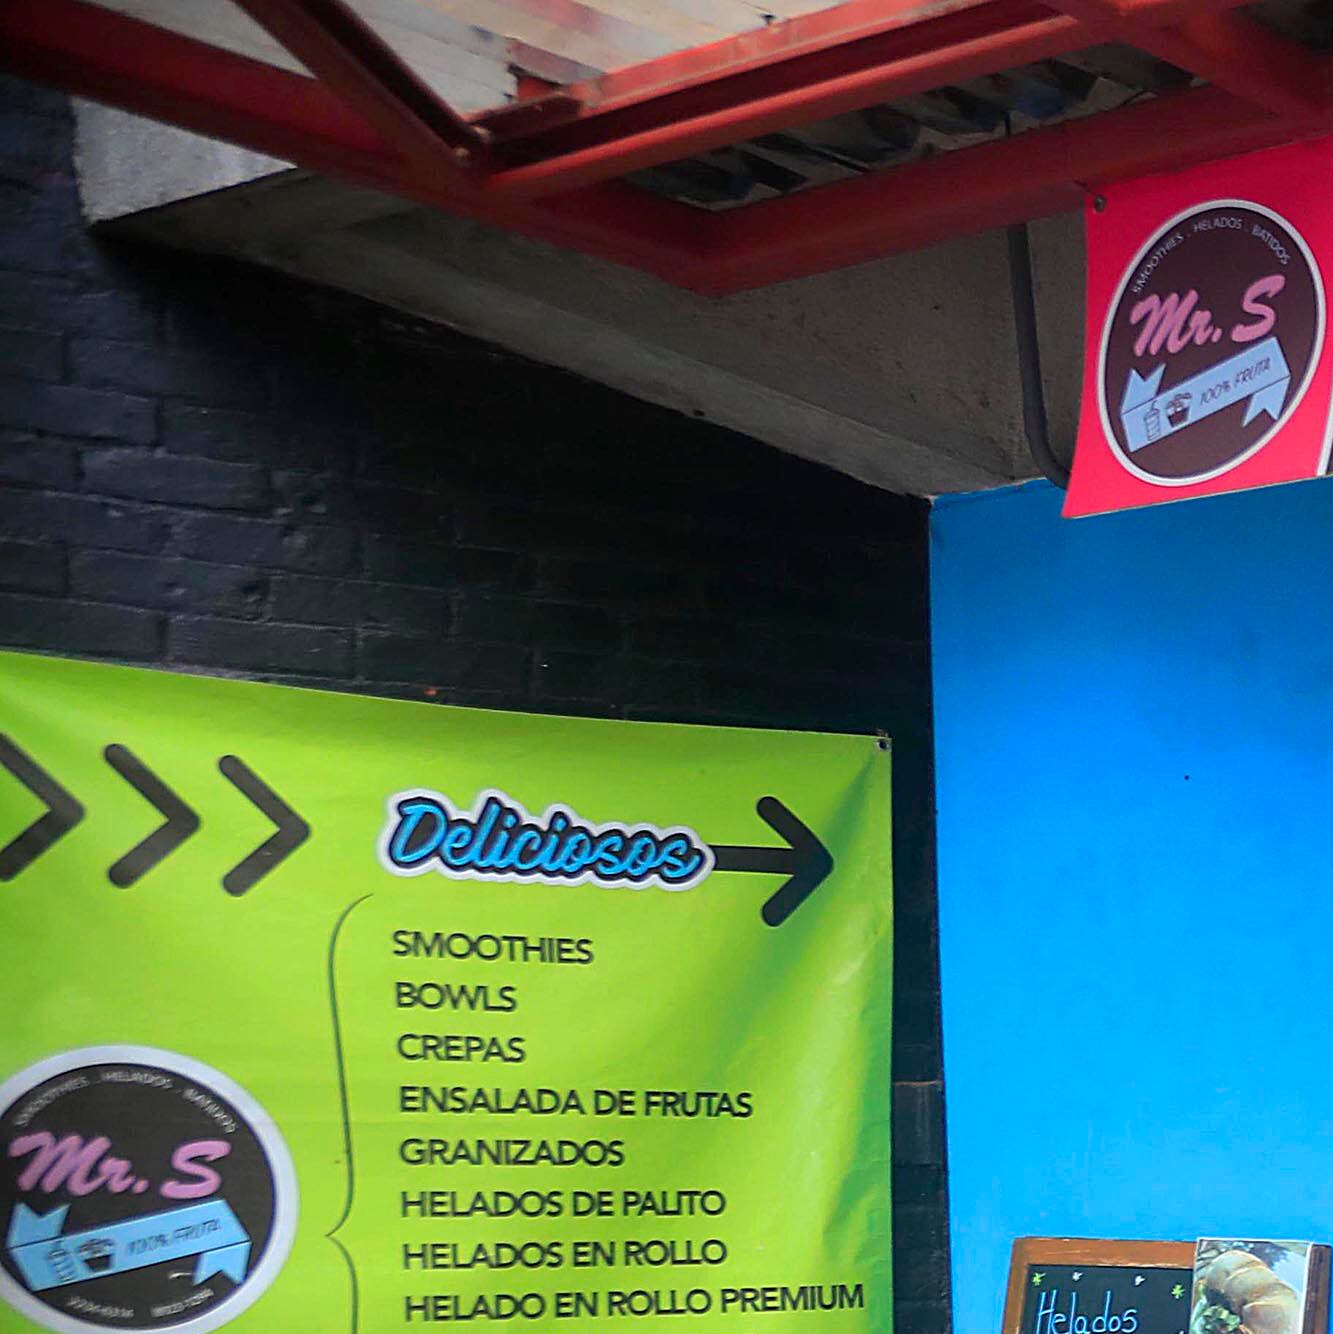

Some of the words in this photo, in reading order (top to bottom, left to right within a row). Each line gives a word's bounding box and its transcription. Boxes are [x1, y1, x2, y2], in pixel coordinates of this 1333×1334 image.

[1193, 216, 1243, 233] HELADOS
[1252, 224, 1290, 266] BATIDOS
[1129, 289, 1222, 356] Mr.
[1231, 274, 1285, 343] S
[1234, 358, 1272, 391] FRUTA
[388, 795, 701, 880] Deliciosos
[392, 929, 594, 965] SMOOTHIES
[395, 981, 517, 1013] BOWLS
[397, 1033, 525, 1064] CREPAS
[400, 1086, 586, 1115] ENSALADA
[594, 1089, 636, 1117] DE
[644, 1092, 753, 1119] FRUTAS
[8, 1130, 150, 1195] Mr.
[160, 1140, 232, 1199] S
[401, 1138, 625, 1167] GRANIZADOS
[401, 1191, 563, 1217] HELADOS
[573, 1191, 614, 1216] DE
[623, 1190, 726, 1216] PALITO
[403, 1242, 564, 1269] HELADOS
[573, 1241, 615, 1267] EN
[624, 1240, 727, 1267] ROLLO
[405, 1293, 545, 1322] HELADO
[555, 1291, 598, 1318] EN
[607, 1288, 711, 1316] ROLLO
[721, 1284, 865, 1313] PREMIUM
